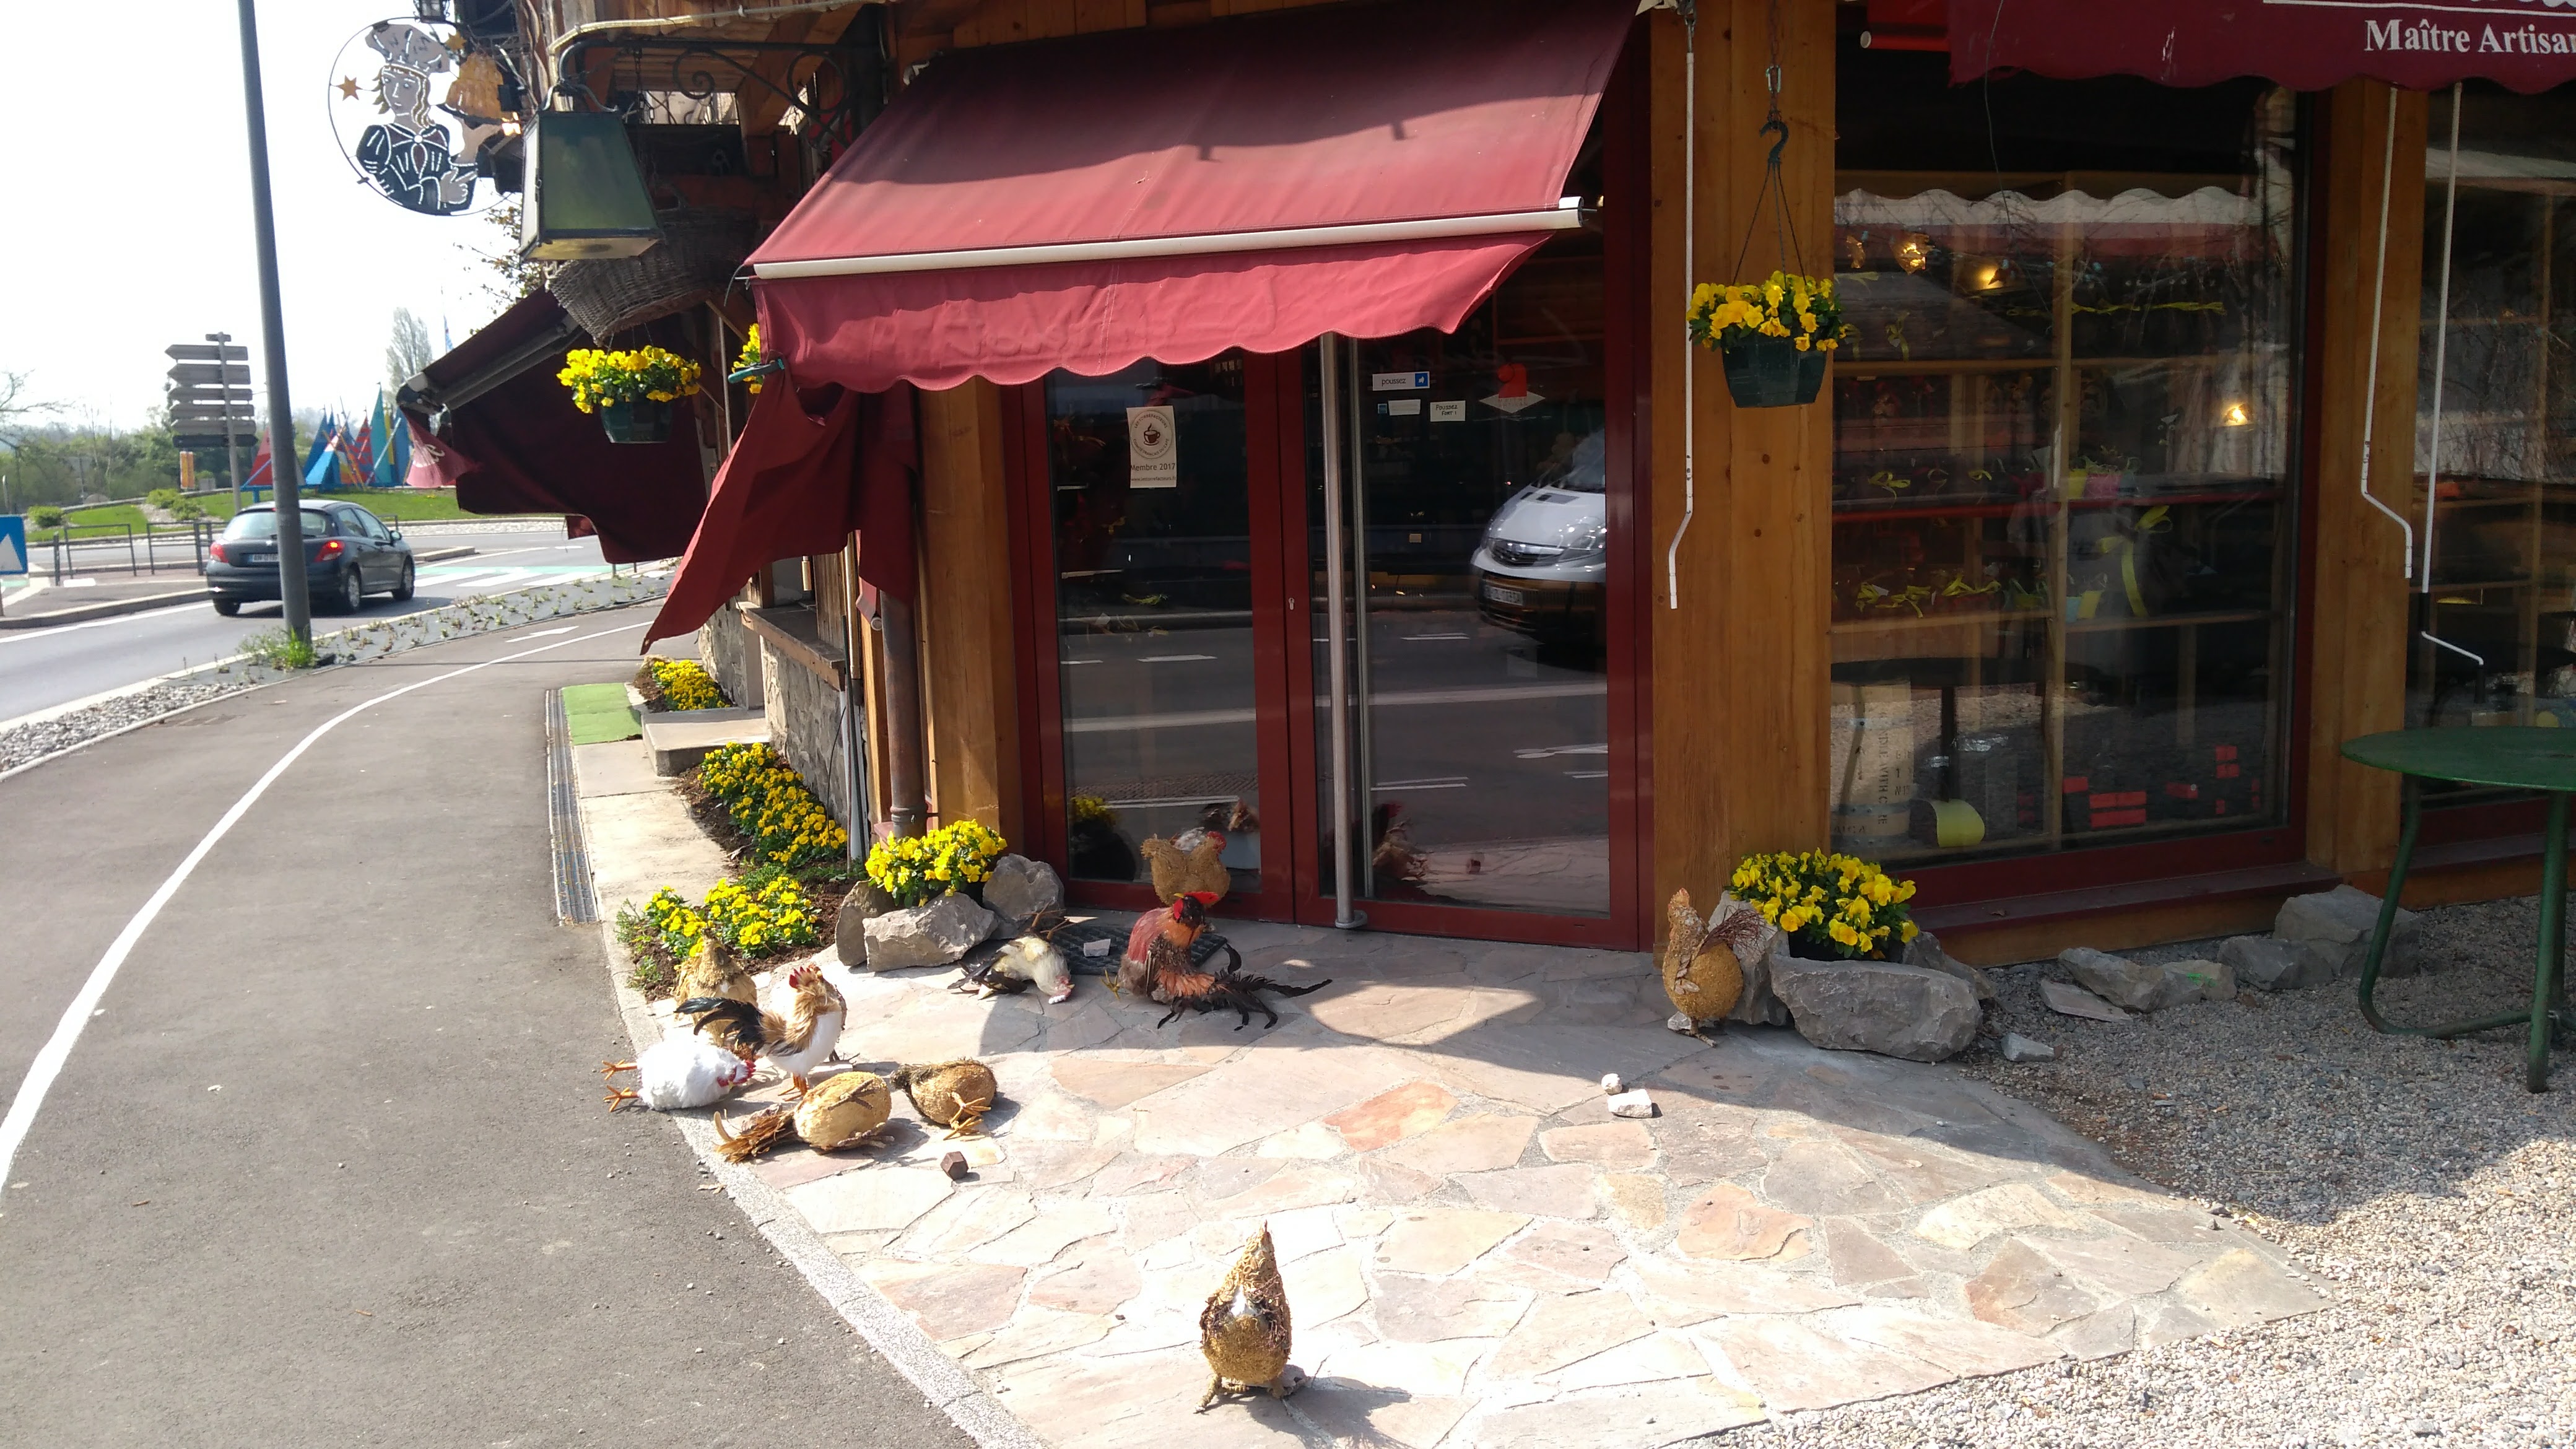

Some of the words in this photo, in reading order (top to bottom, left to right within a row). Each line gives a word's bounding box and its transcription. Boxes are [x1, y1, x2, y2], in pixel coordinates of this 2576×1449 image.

[2364, 19, 2470, 53] Maître
[1382, 378, 1406, 387] poussez
[1139, 414, 1167, 429] TORRÉFACTEURS
[1159, 463, 1175, 471] 2017
